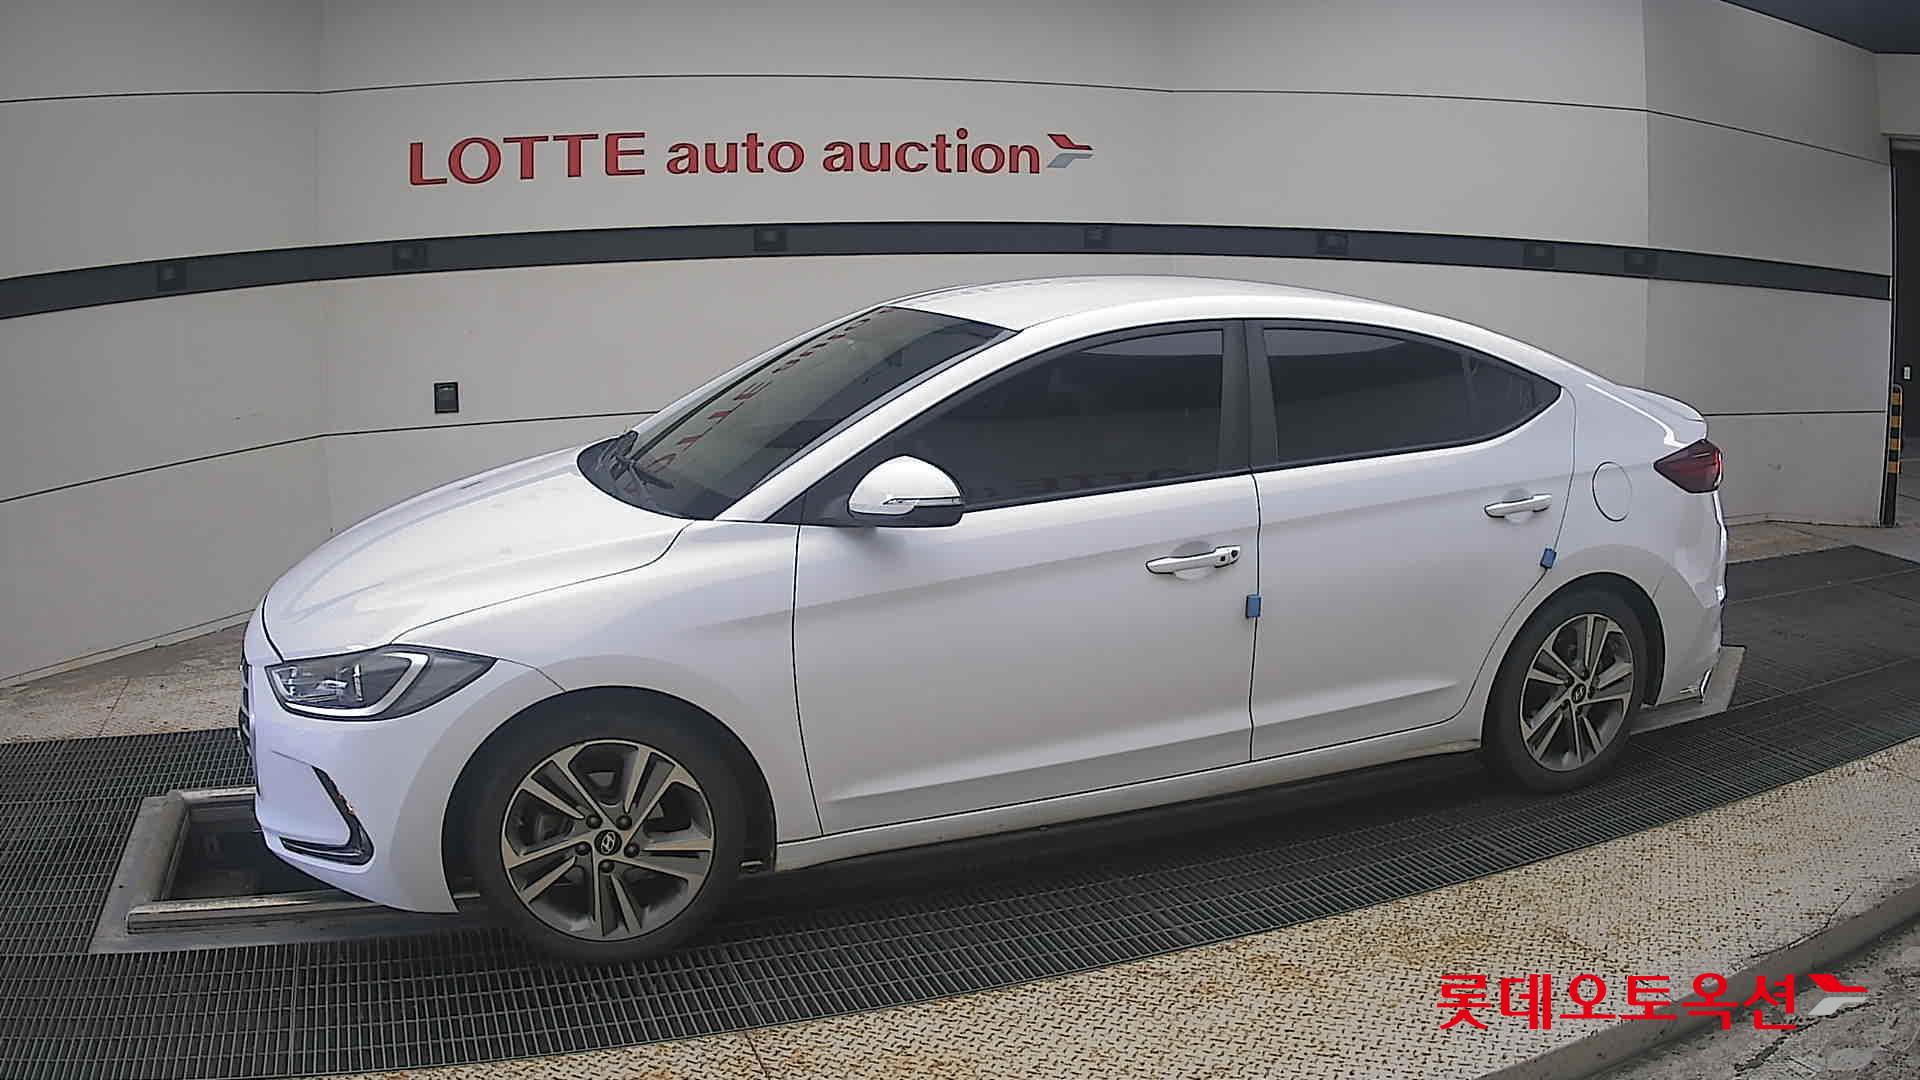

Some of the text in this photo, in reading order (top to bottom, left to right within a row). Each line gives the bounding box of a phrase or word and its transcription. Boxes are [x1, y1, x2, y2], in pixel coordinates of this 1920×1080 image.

[409, 128, 1041, 186] LOTTE auto auction
